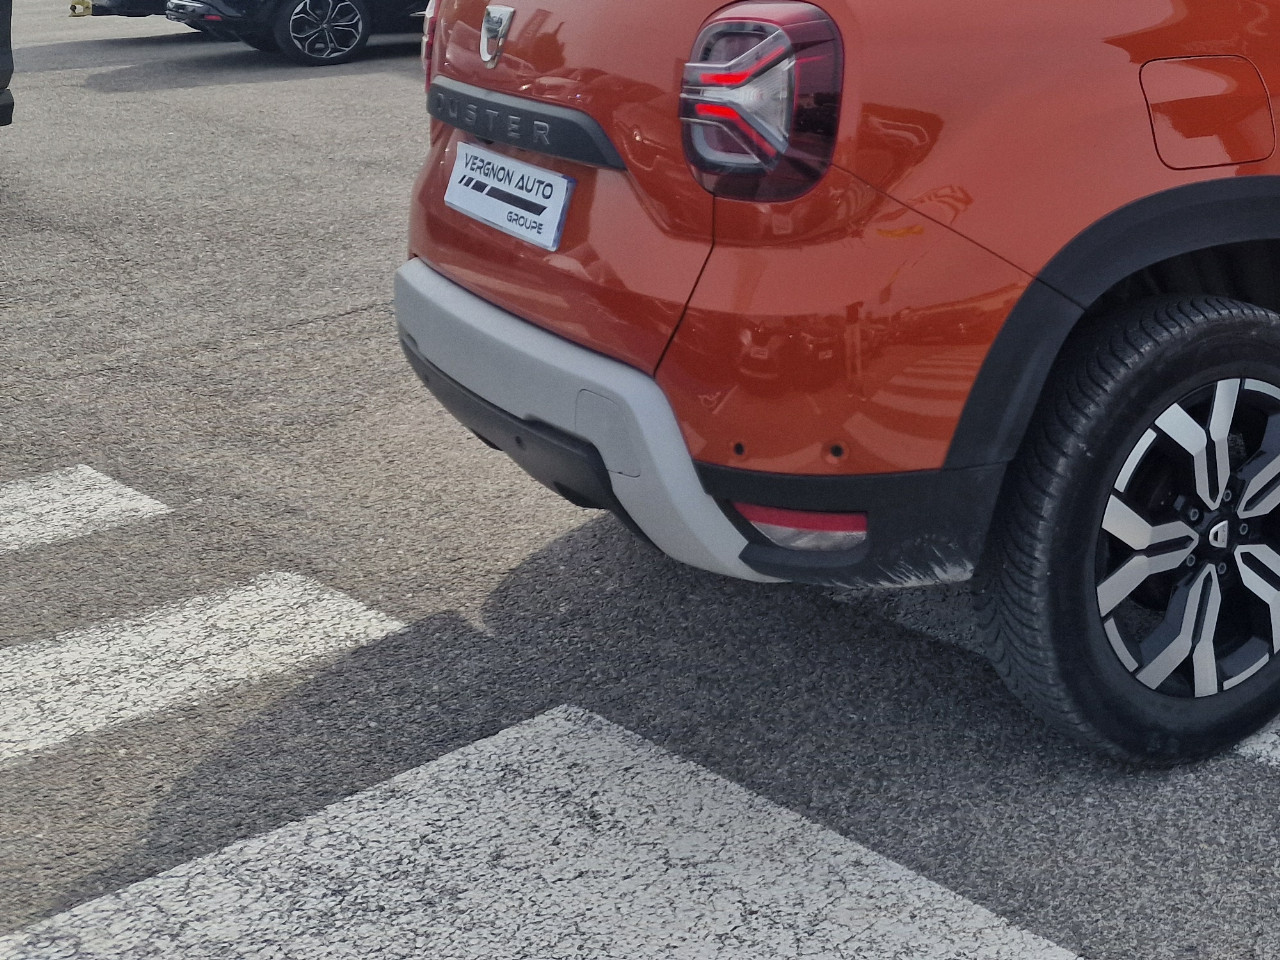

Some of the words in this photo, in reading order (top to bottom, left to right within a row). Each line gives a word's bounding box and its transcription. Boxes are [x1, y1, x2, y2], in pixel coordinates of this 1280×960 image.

[464, 152, 515, 186] VERGNON
[514, 174, 554, 200] AUTO
[506, 211, 544, 235] GROUPE
